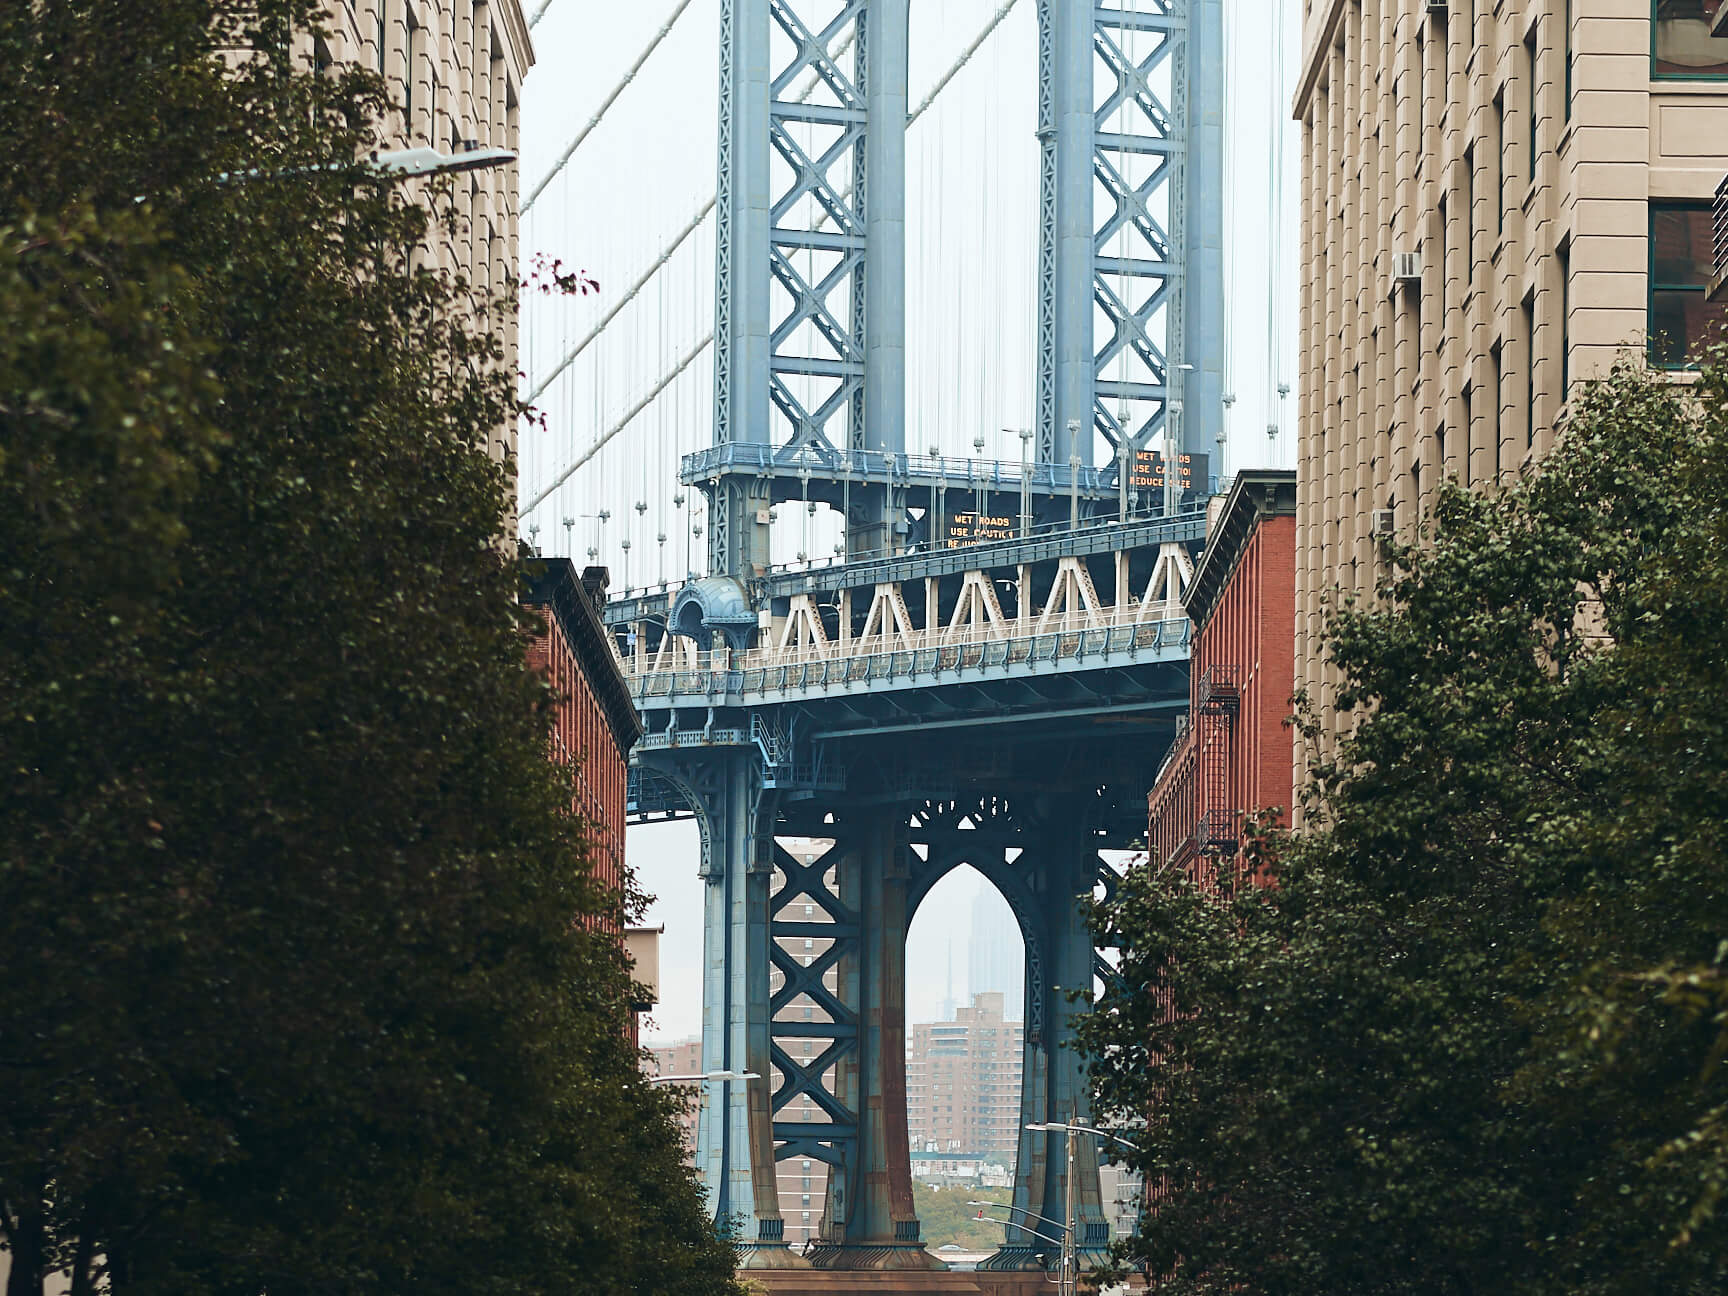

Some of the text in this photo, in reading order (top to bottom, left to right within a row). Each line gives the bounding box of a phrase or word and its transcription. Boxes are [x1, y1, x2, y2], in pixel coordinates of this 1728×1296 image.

[1136, 452, 1155, 461] WET
[1132, 464, 1150, 473] USE
[954, 515, 1009, 526] WET ROADS
[950, 528, 968, 536] USE
